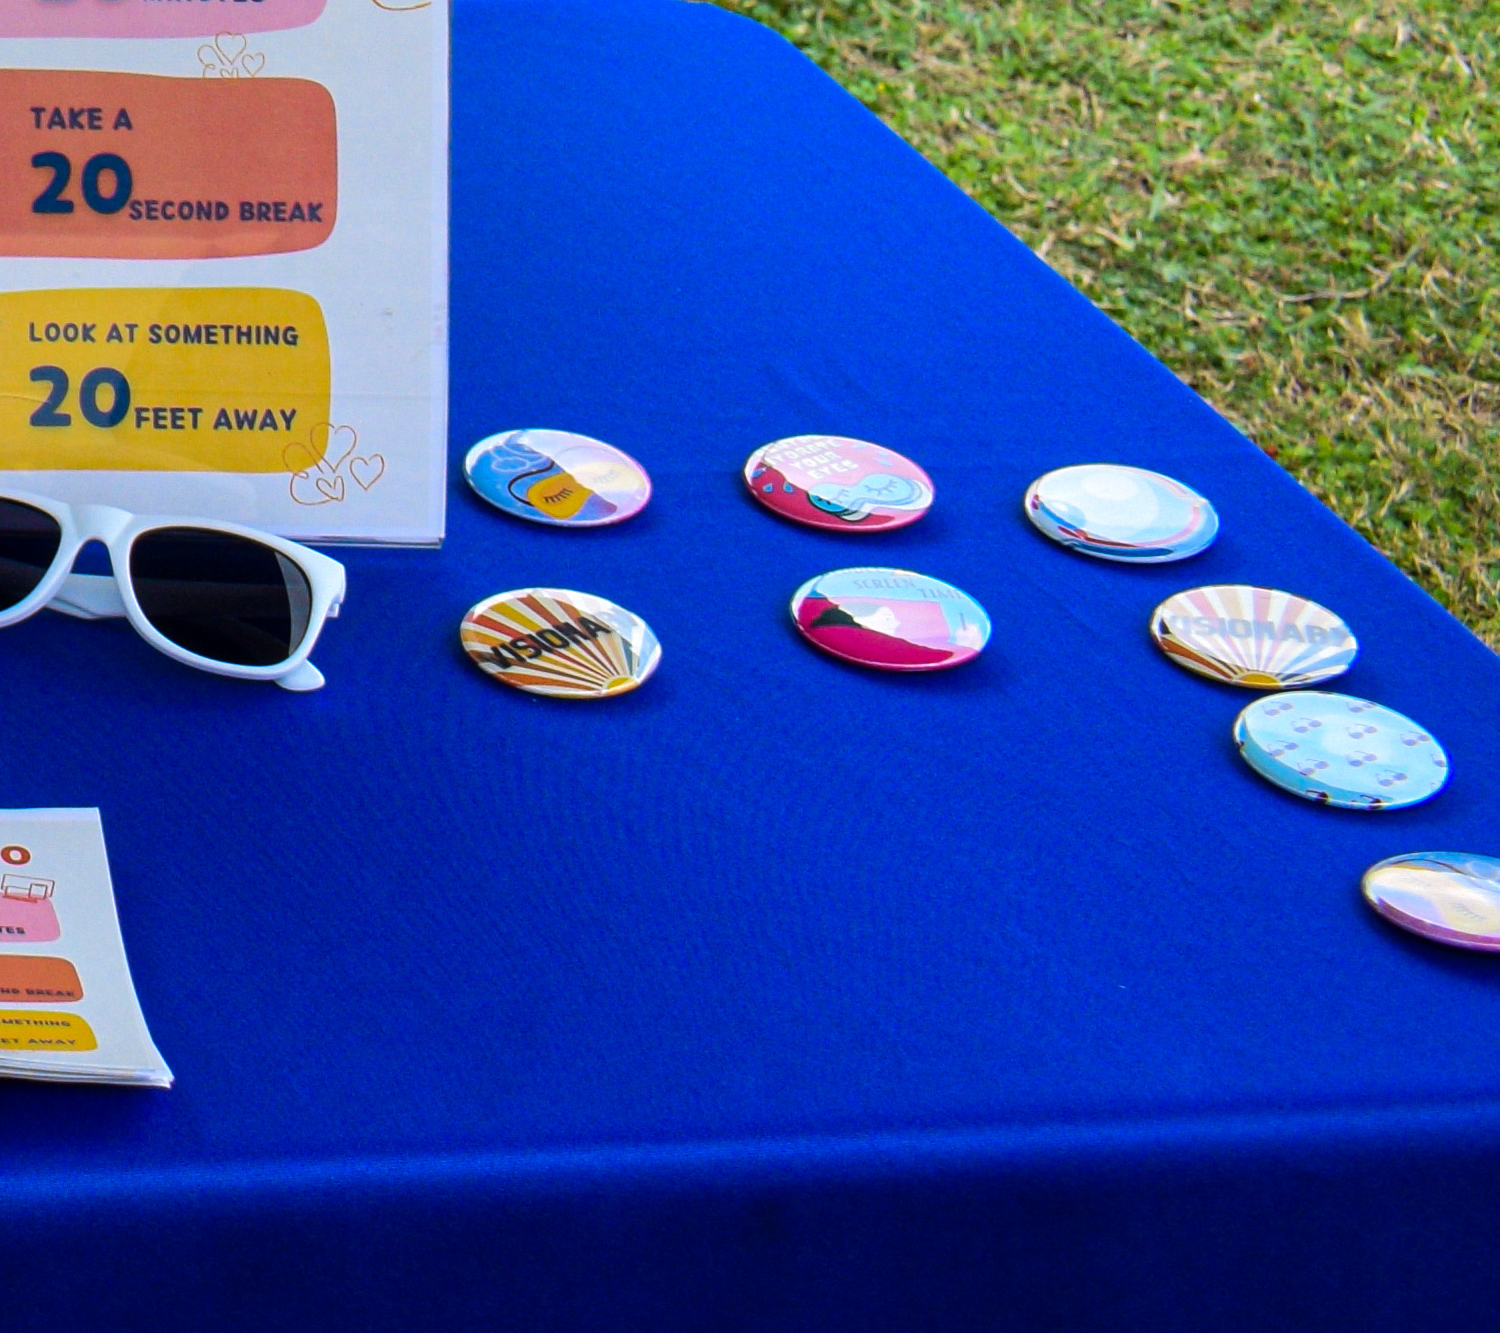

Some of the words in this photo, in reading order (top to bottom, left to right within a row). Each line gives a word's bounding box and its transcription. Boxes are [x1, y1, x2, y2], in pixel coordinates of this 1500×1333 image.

[30, 107, 103, 130] TAKE
[113, 108, 134, 130] A
[31, 151, 134, 215] 20
[129, 200, 230, 221] SECOND
[239, 201, 323, 222] BREAK
[29, 322, 96, 343] LOOK
[105, 323, 138, 343] AT
[148, 324, 299, 347] SOMETHING
[28, 365, 131, 429] 20
[135, 406, 203, 430] FEET
[213, 407, 297, 432] AWAY
[26, 988, 75, 998] BREAK
[28, 1038, 77, 1046] AWAY
